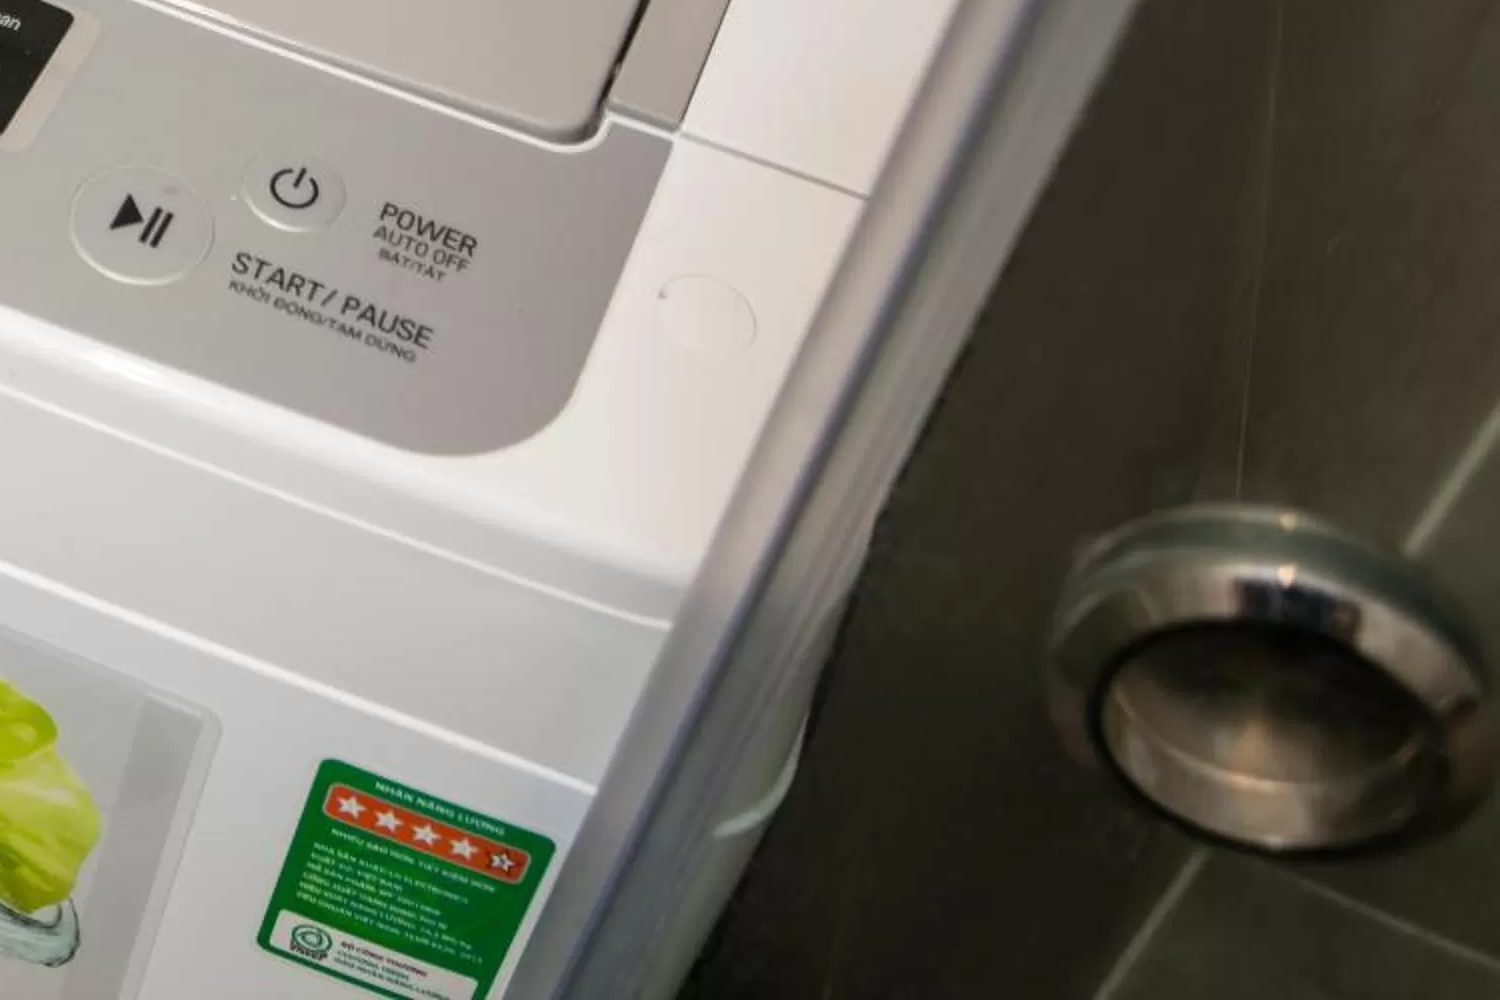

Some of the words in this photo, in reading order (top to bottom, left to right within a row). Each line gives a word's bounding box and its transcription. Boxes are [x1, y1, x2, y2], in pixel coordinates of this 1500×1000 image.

[372, 224, 429, 258] AUTO
[432, 247, 472, 273] OFF
[379, 201, 478, 257] POWER
[340, 295, 435, 350] PAUSE
